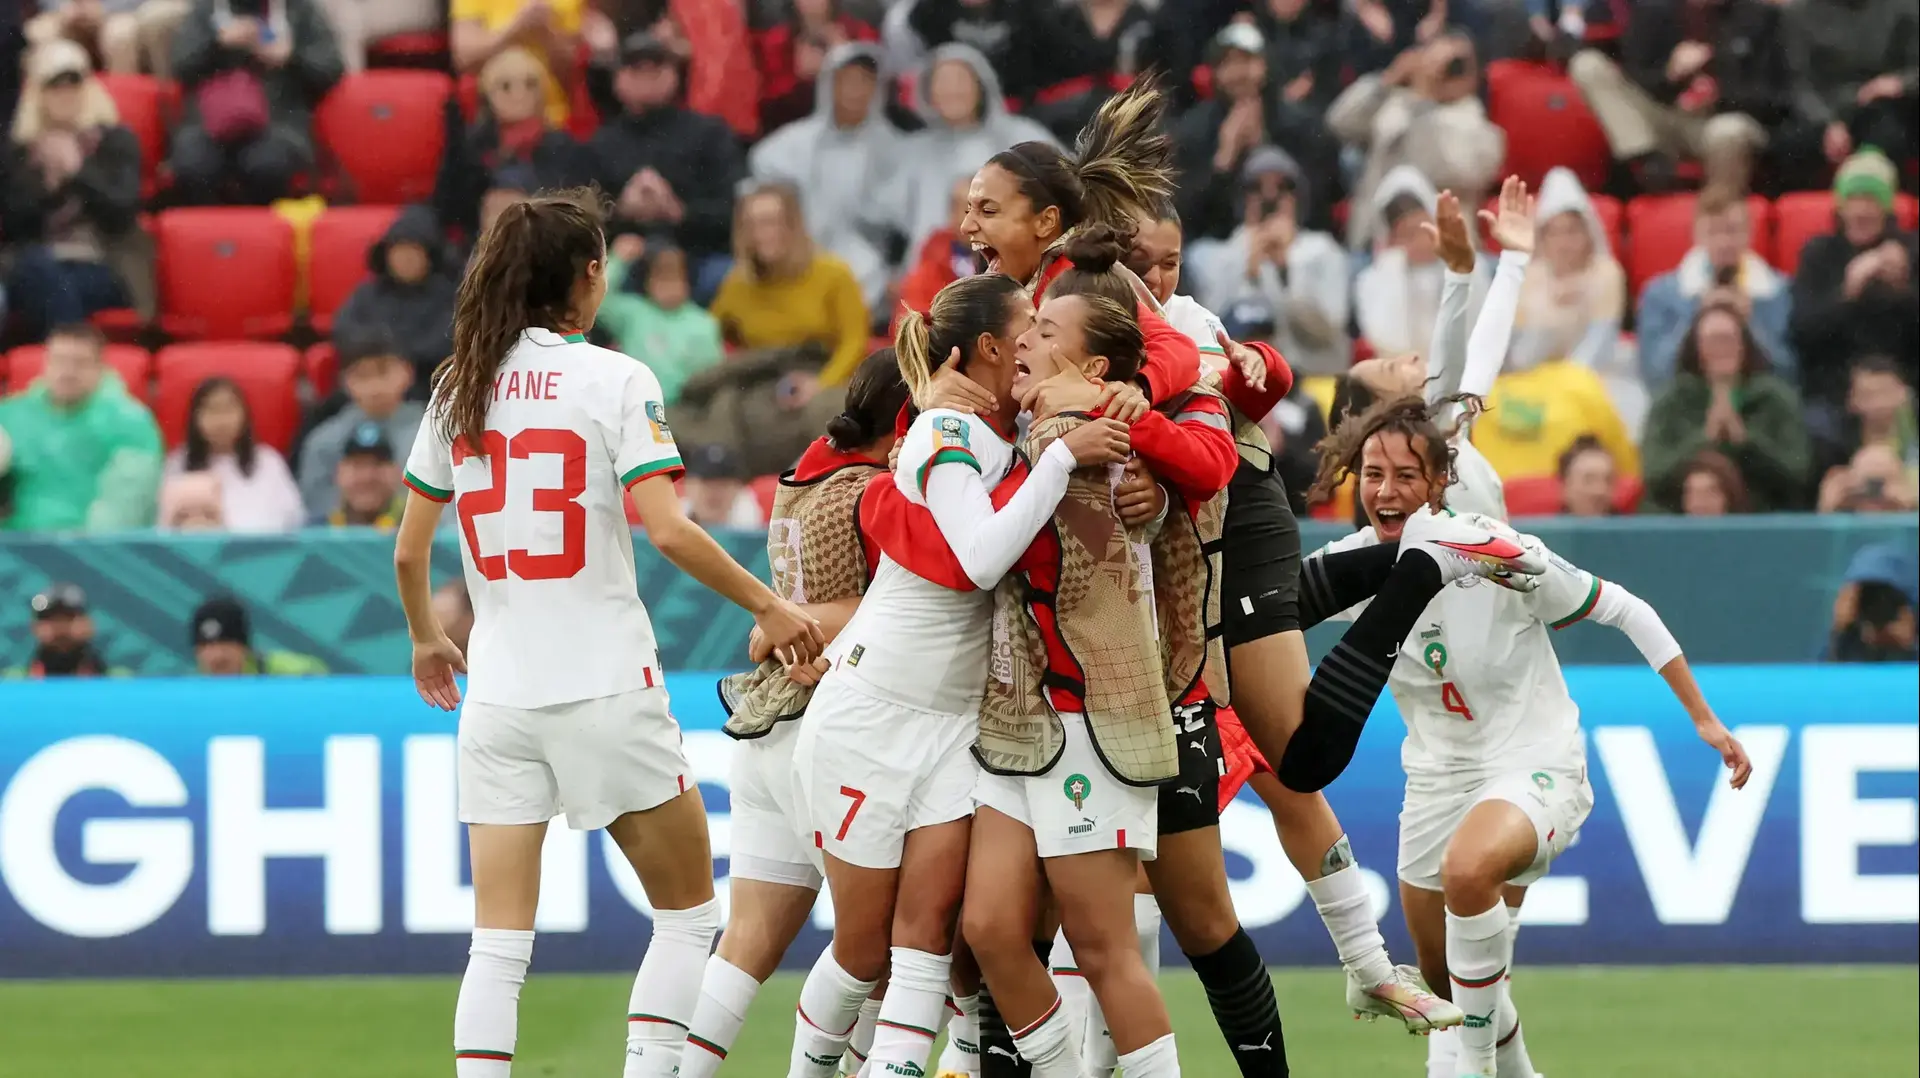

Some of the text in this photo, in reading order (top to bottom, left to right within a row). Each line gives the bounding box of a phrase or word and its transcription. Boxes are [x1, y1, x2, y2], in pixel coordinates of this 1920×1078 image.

[488, 371, 563, 401] YANE
[452, 428, 587, 582] 23
[1173, 700, 1206, 733] 2
[1441, 682, 1474, 721] 4
[835, 785, 866, 841] 7
[1068, 824, 1092, 834] PUMA
[1500, 724, 1919, 926] VE
